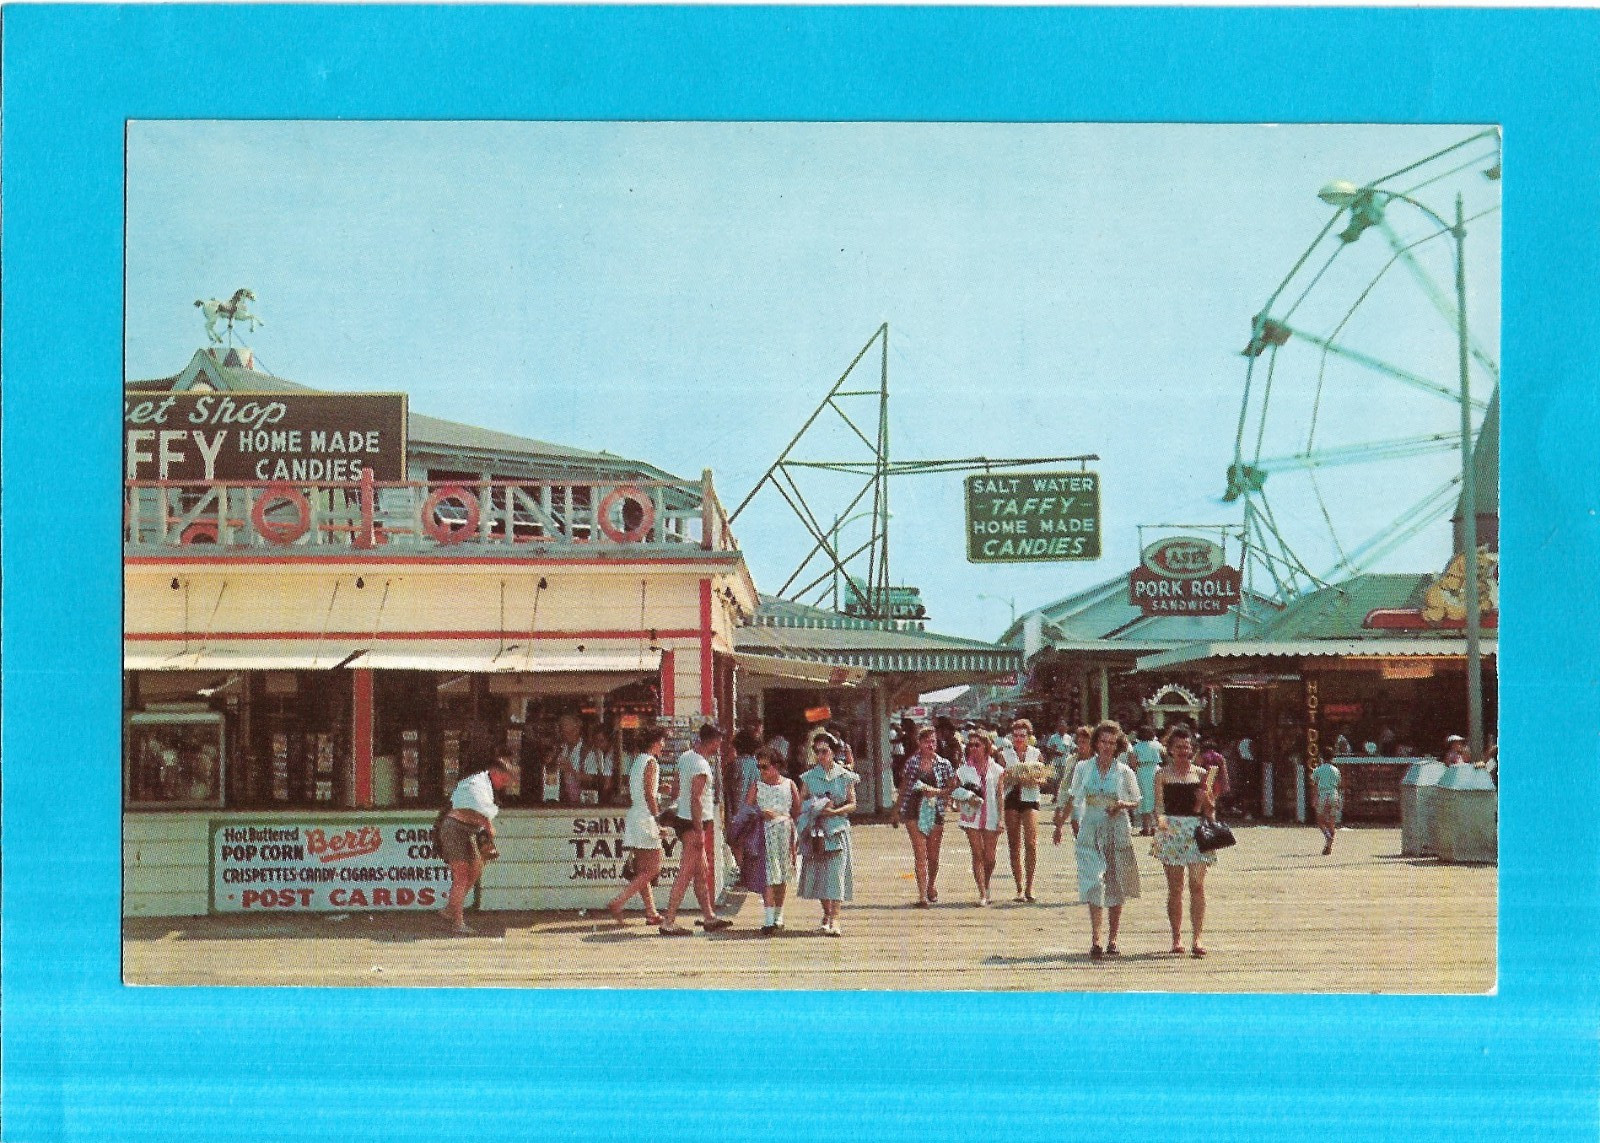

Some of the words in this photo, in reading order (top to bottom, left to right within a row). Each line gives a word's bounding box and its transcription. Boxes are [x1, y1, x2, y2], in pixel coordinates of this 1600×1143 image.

[188, 395, 287, 430] Shop
[239, 430, 302, 453] HOME
[310, 431, 381, 453] MADE
[255, 458, 363, 481] CANDIES
[973, 479, 1020, 493] SALT
[1033, 477, 1094, 492] WATER
[991, 496, 1077, 515] TAFFY
[973, 520, 1028, 534] HOME
[1040, 518, 1095, 533] MADE
[983, 537, 1087, 556] CANDIES
[1135, 580, 1184, 598] PORK
[1190, 580, 1236, 598] ROLL
[1152, 600, 1221, 612] SANDWICH
[1308, 680, 1318, 723] HOT
[1308, 728, 1318, 785] DOG
[224, 828, 247, 843] Hot
[249, 827, 299, 843] Buttered
[573, 818, 611, 834] Salt
[222, 845, 257, 862] POP
[260, 845, 304, 861] CORN
[408, 845, 436, 859] CO
[569, 838, 678, 859] TAY
[388, 867, 453, 882] CIGARETT
[570, 863, 616, 880] Mailed
[242, 889, 314, 909] POST
[329, 888, 436, 908] CARDS
